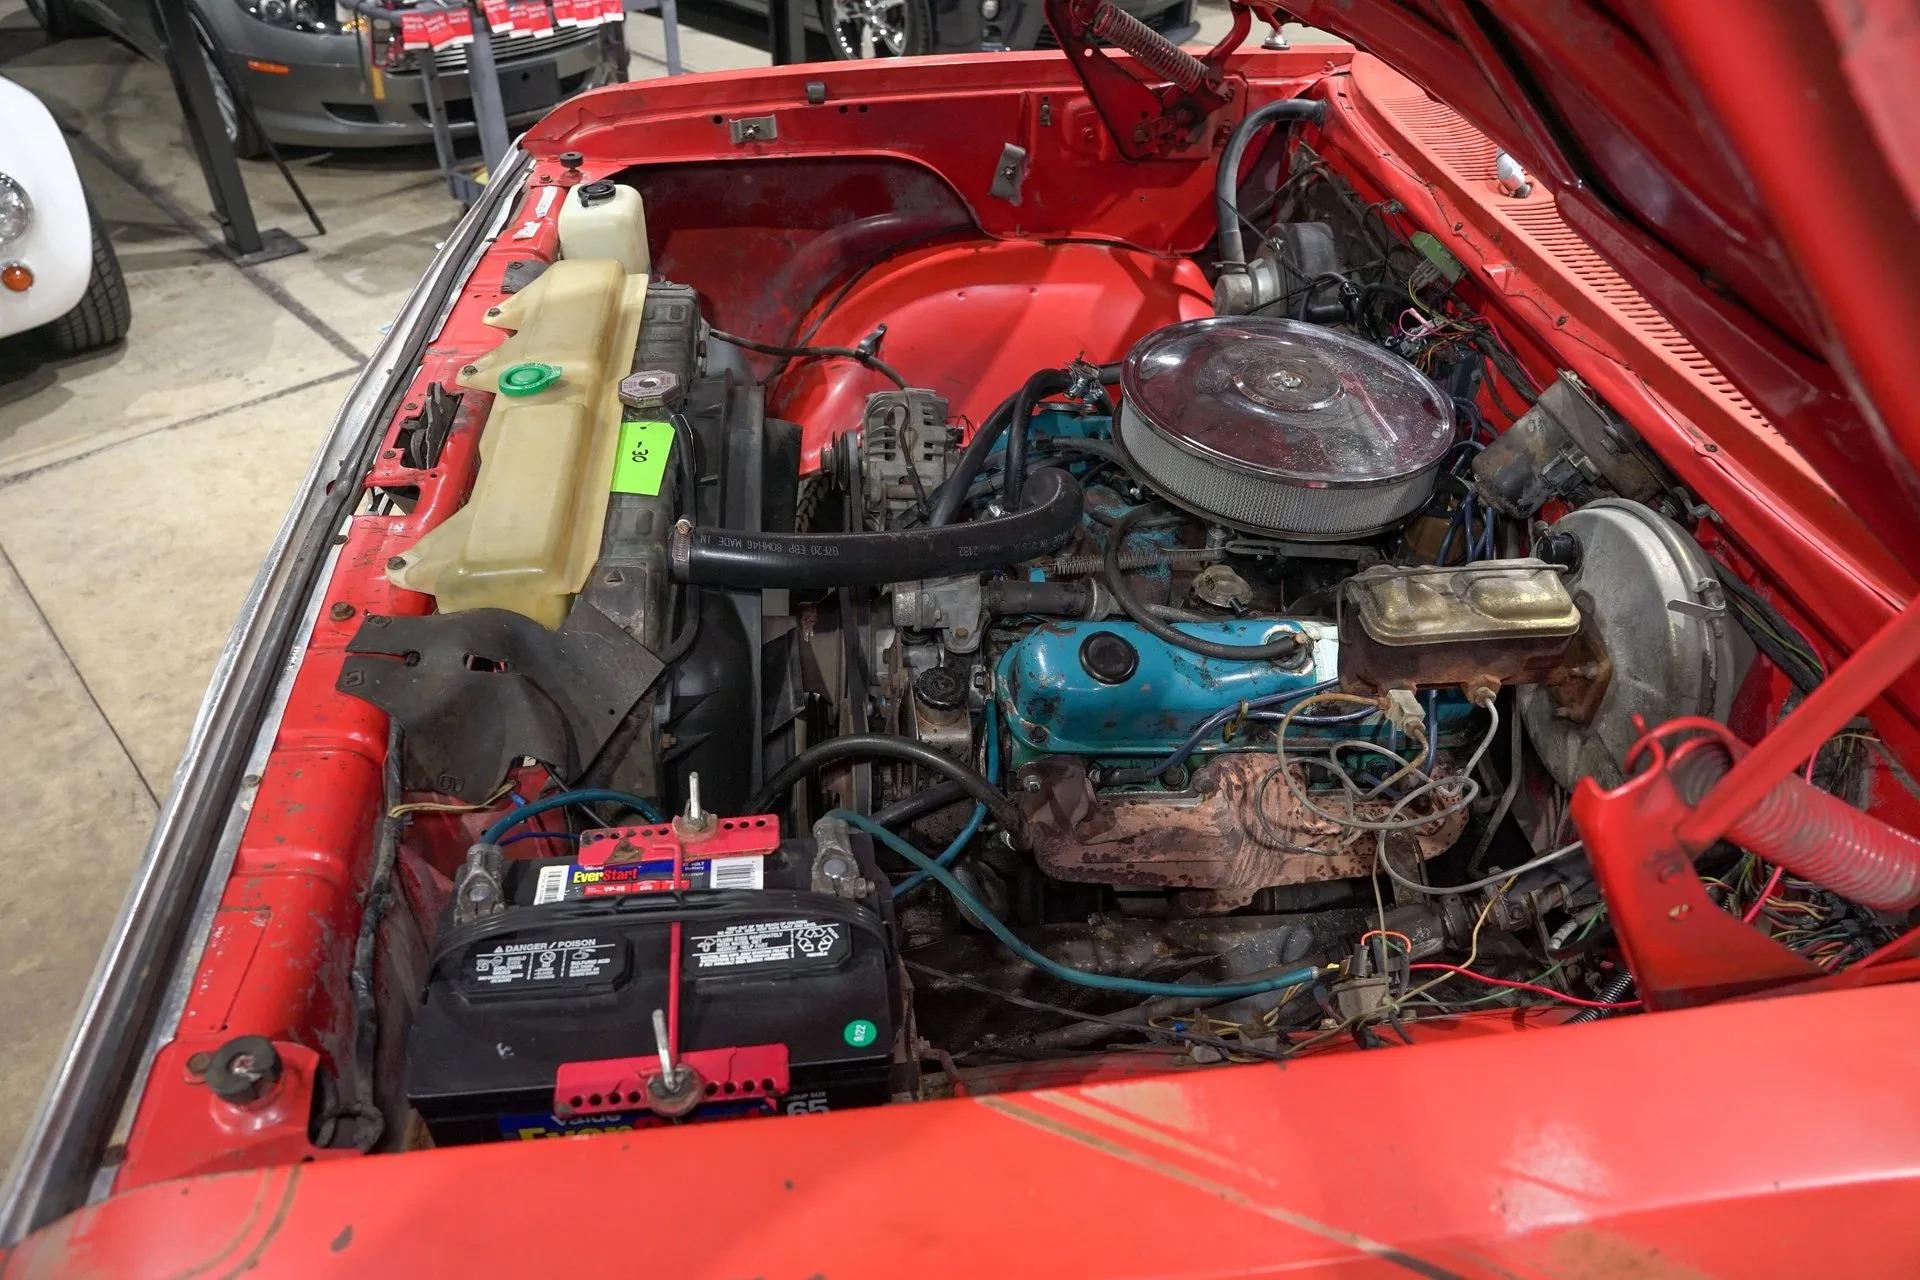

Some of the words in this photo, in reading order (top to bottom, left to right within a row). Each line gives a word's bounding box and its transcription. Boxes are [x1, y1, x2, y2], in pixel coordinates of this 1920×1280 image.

[700, 534, 711, 544] IN
[719, 536, 742, 548] MADE
[573, 868, 638, 885] EverStart
[505, 942, 548, 953] DANGER
[557, 938, 596, 949] POISON
[786, 1098, 830, 1117] 65
